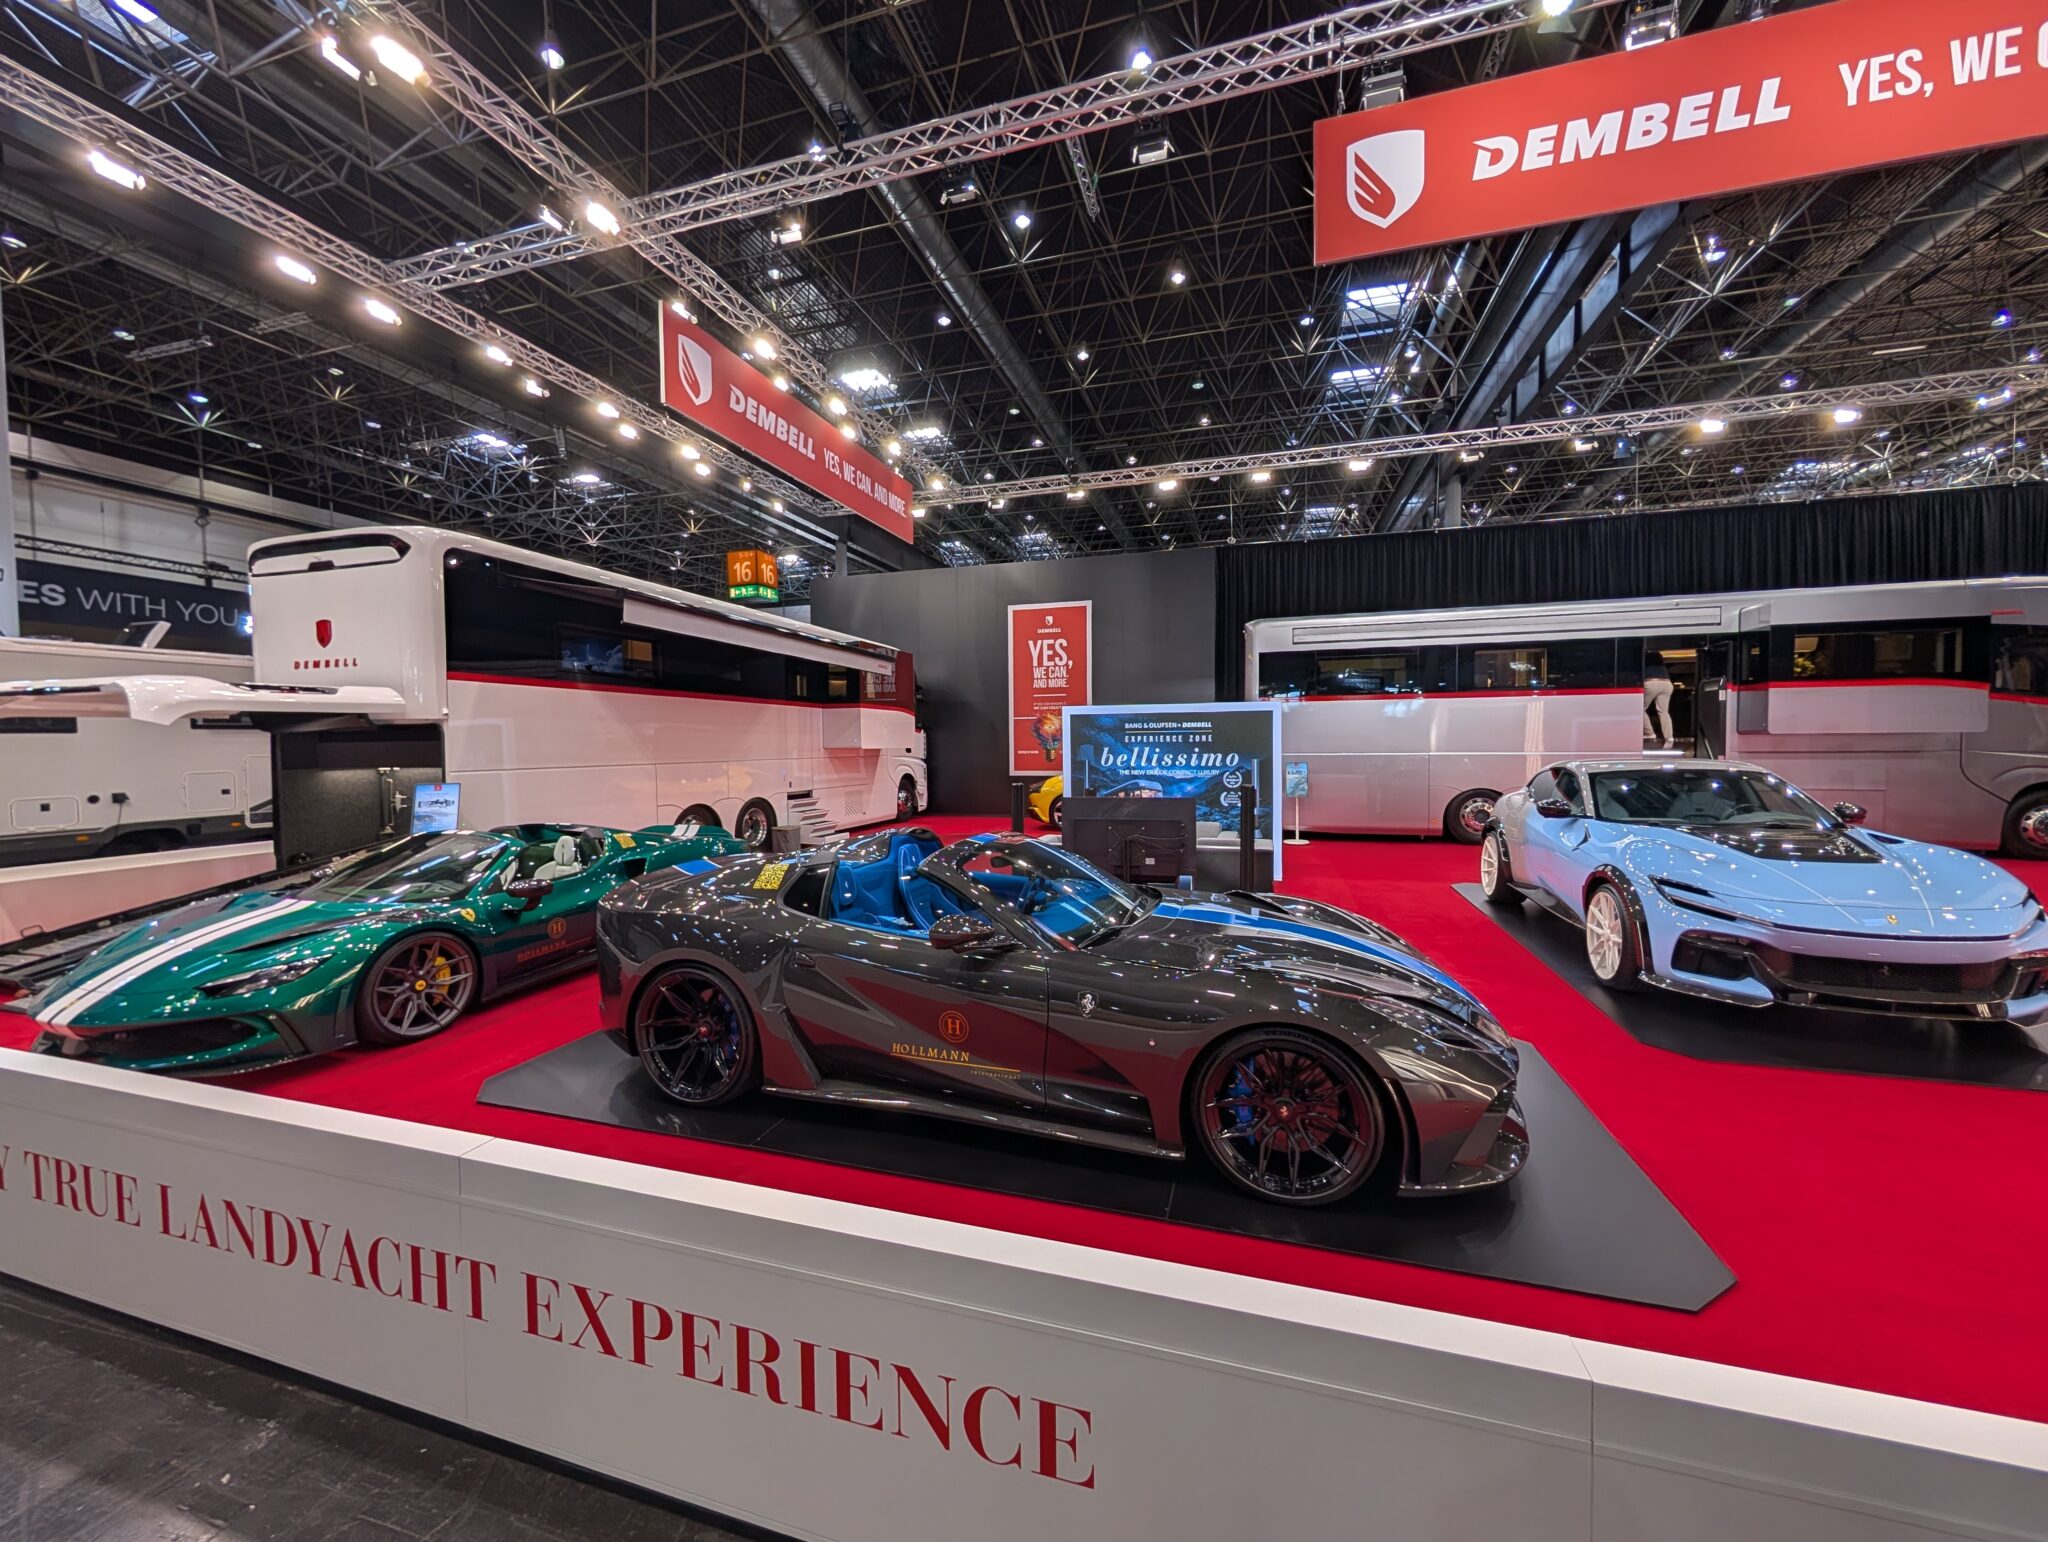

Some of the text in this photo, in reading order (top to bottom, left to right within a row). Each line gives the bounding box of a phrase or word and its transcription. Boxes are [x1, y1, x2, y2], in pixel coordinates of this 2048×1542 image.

[1838, 49, 1934, 107] YES,
[1950, 26, 2023, 86] WE
[1472, 77, 1791, 181] DEMBELL
[729, 383, 816, 461] DEMBELL
[823, 447, 907, 519] YES, WE CAN. AND MORE.
[733, 561, 752, 583] 16
[760, 563, 775, 585] 16
[76, 587, 167, 619] WITH
[176, 600, 238, 627] YOU
[294, 658, 360, 670] DEMBELL
[1028, 638, 1073, 669] YES,
[1033, 666, 1069, 679] WE CAN.
[1033, 677, 1070, 689] AND MORE.
[1149, 721, 1178, 729] OLUFSEN
[1125, 734, 1212, 743] EXPERIENCE ZONE
[1101, 746, 1239, 767] bellissimo
[947, 1018, 961, 1035] H
[892, 1042, 970, 1062] HOLLMANN
[24, 1151, 1096, 1490] TRUE LANDYACHT EXPERIENCE
